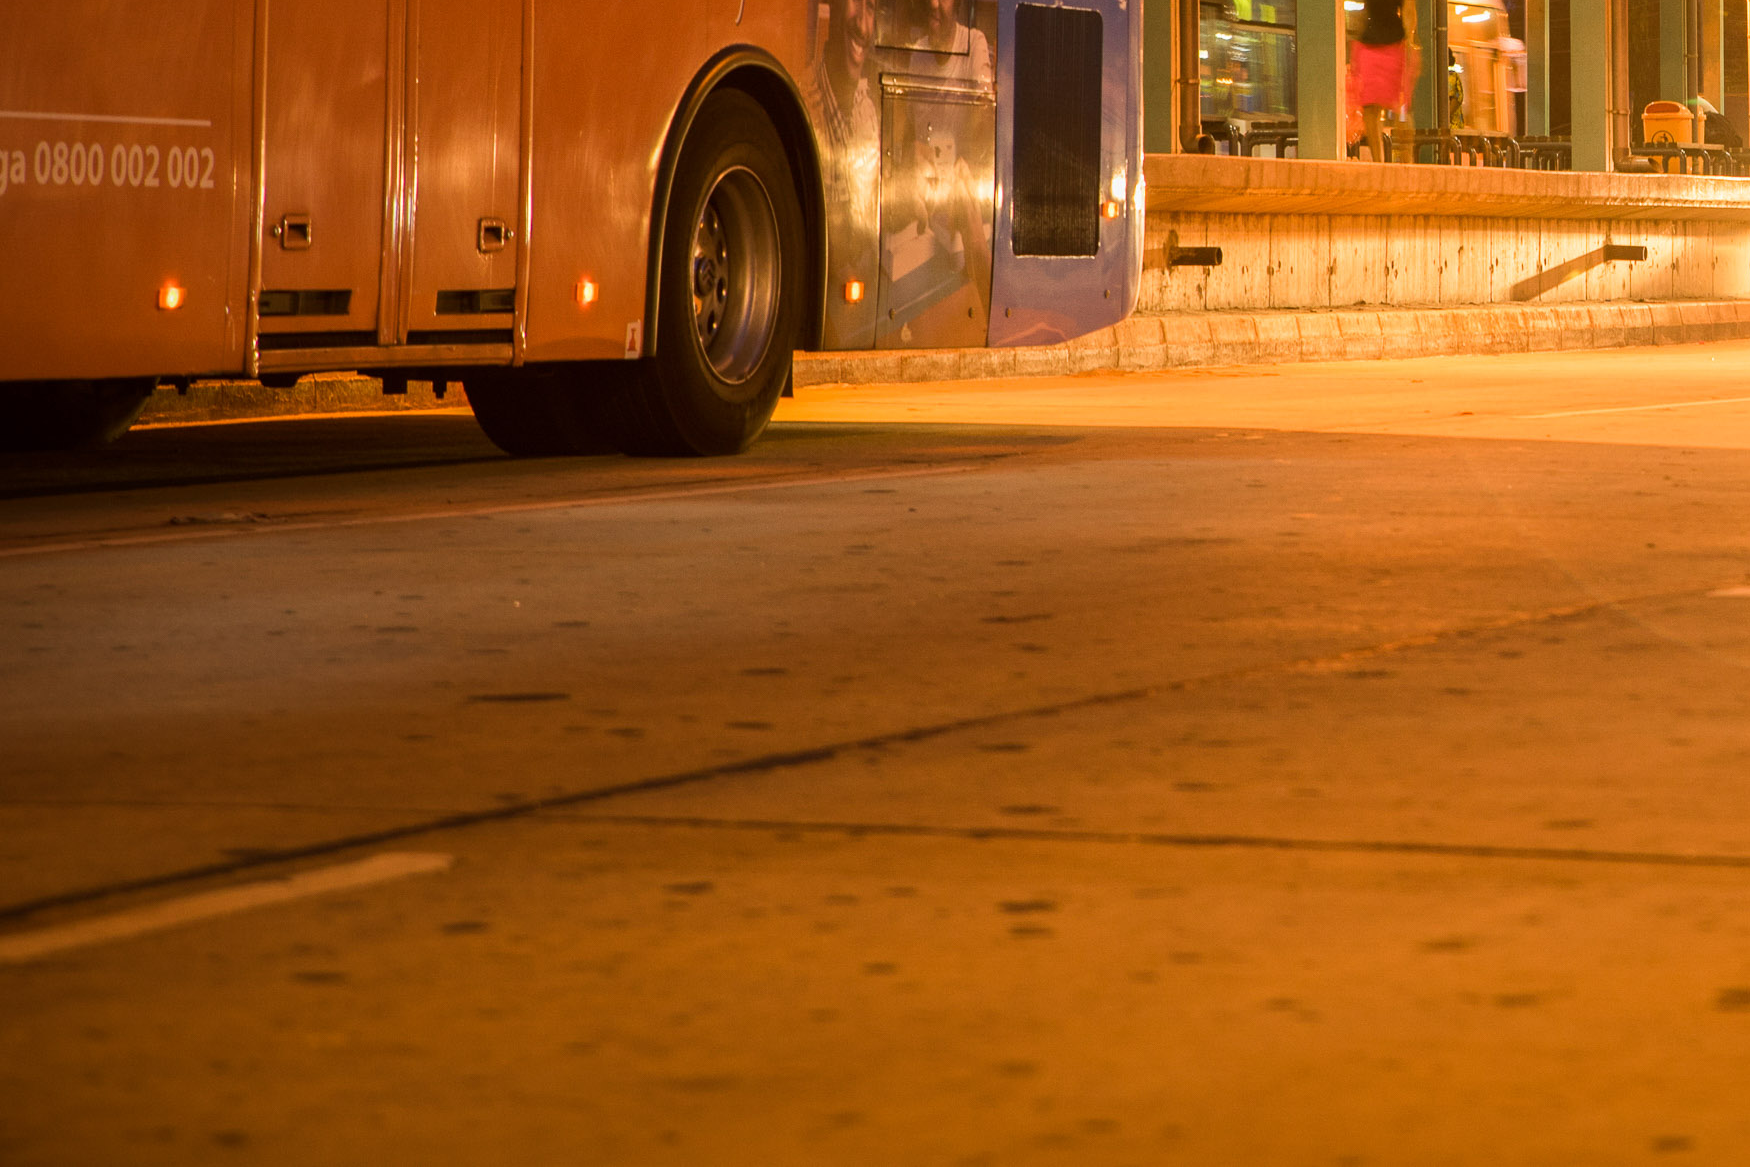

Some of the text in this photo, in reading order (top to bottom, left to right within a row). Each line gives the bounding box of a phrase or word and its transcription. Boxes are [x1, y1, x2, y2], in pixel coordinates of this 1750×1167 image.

[34, 140, 105, 186] 0800
[110, 143, 160, 187] 002
[167, 146, 215, 189] 002
